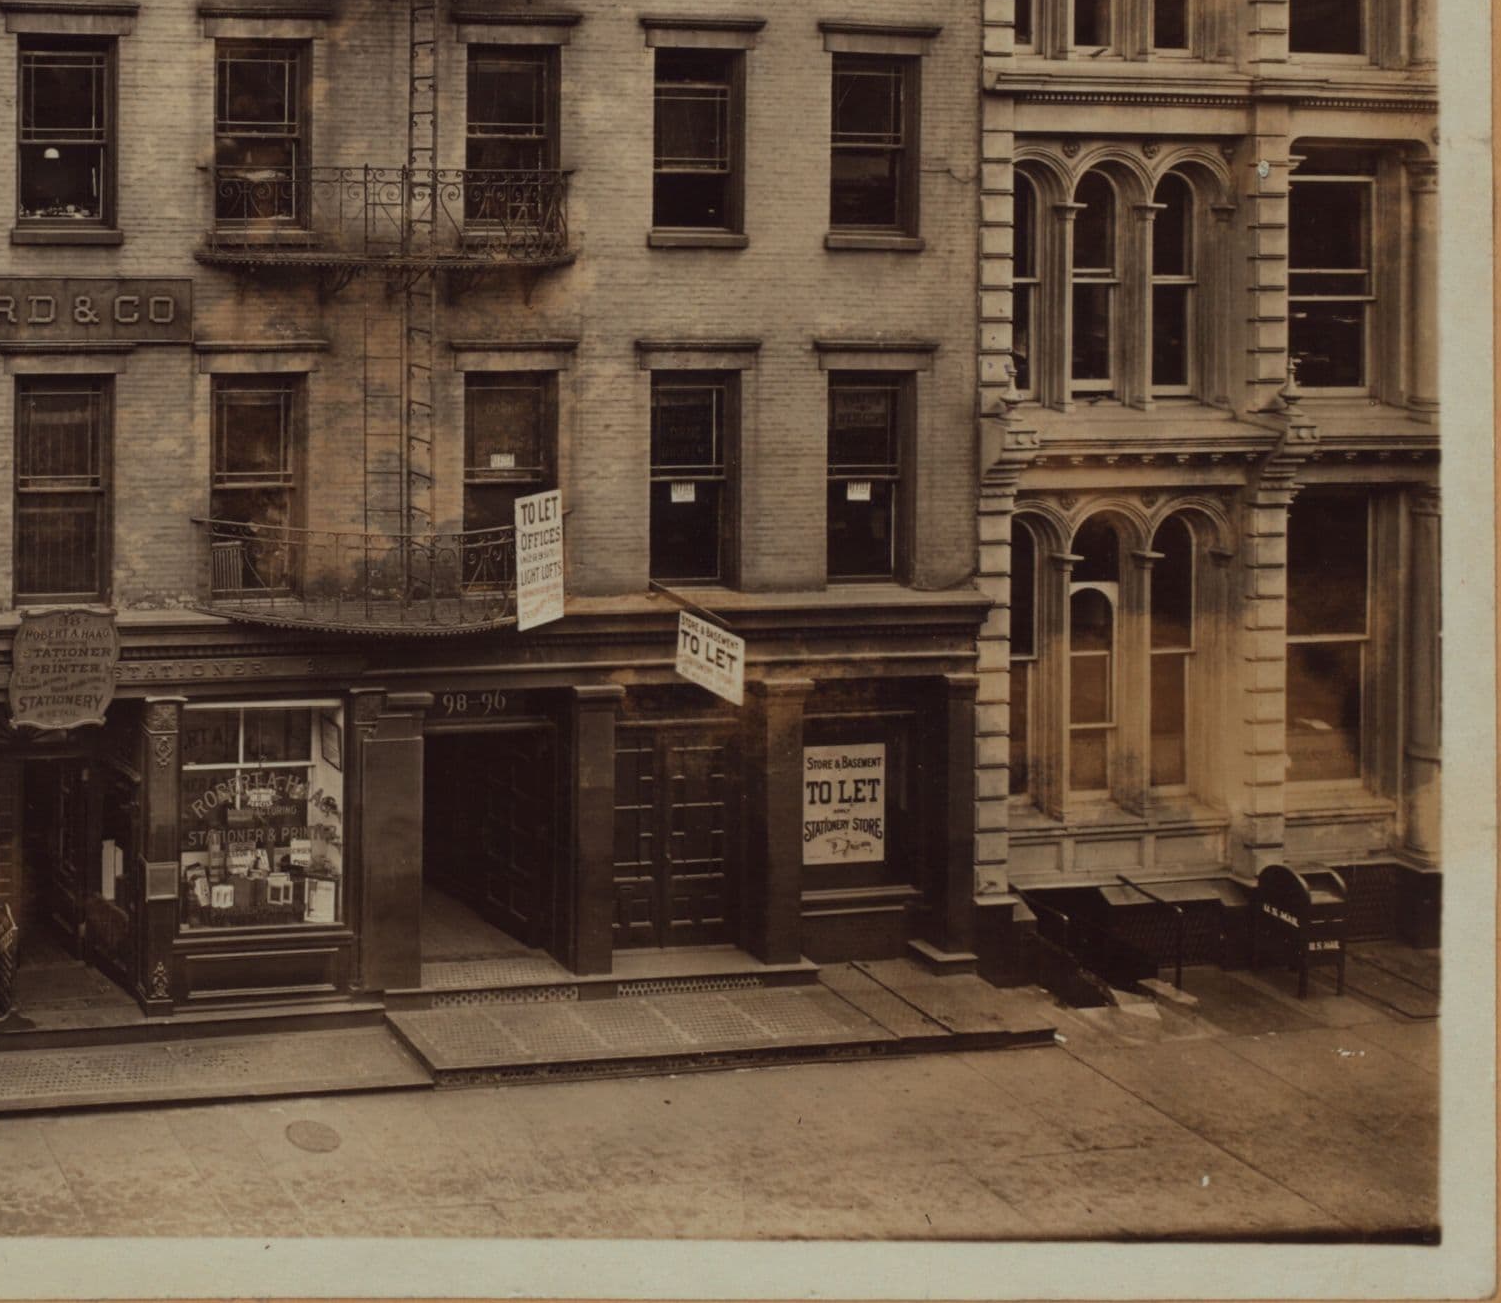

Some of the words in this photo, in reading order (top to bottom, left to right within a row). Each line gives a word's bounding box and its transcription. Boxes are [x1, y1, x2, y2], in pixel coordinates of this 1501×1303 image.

[73, 295, 100, 324] &
[113, 295, 176, 324] CO
[520, 501, 535, 526] TO
[538, 496, 558, 523] LET
[520, 526, 561, 551] OFFICES
[520, 566, 540, 587] LIGHT
[541, 561, 563, 580] LOFTS
[22, 648, 111, 659] STATIONER
[680, 629, 700, 655] TO
[706, 641, 738, 673] LET
[19, 694, 104, 713] STATIONERY
[806, 780, 832, 805] TO
[838, 778, 881, 804] LET
[187, 827, 265, 847] STATIONER
[268, 827, 277, 842] &
[804, 817, 850, 842] STATIONERY
[852, 817, 883, 840] STORE
